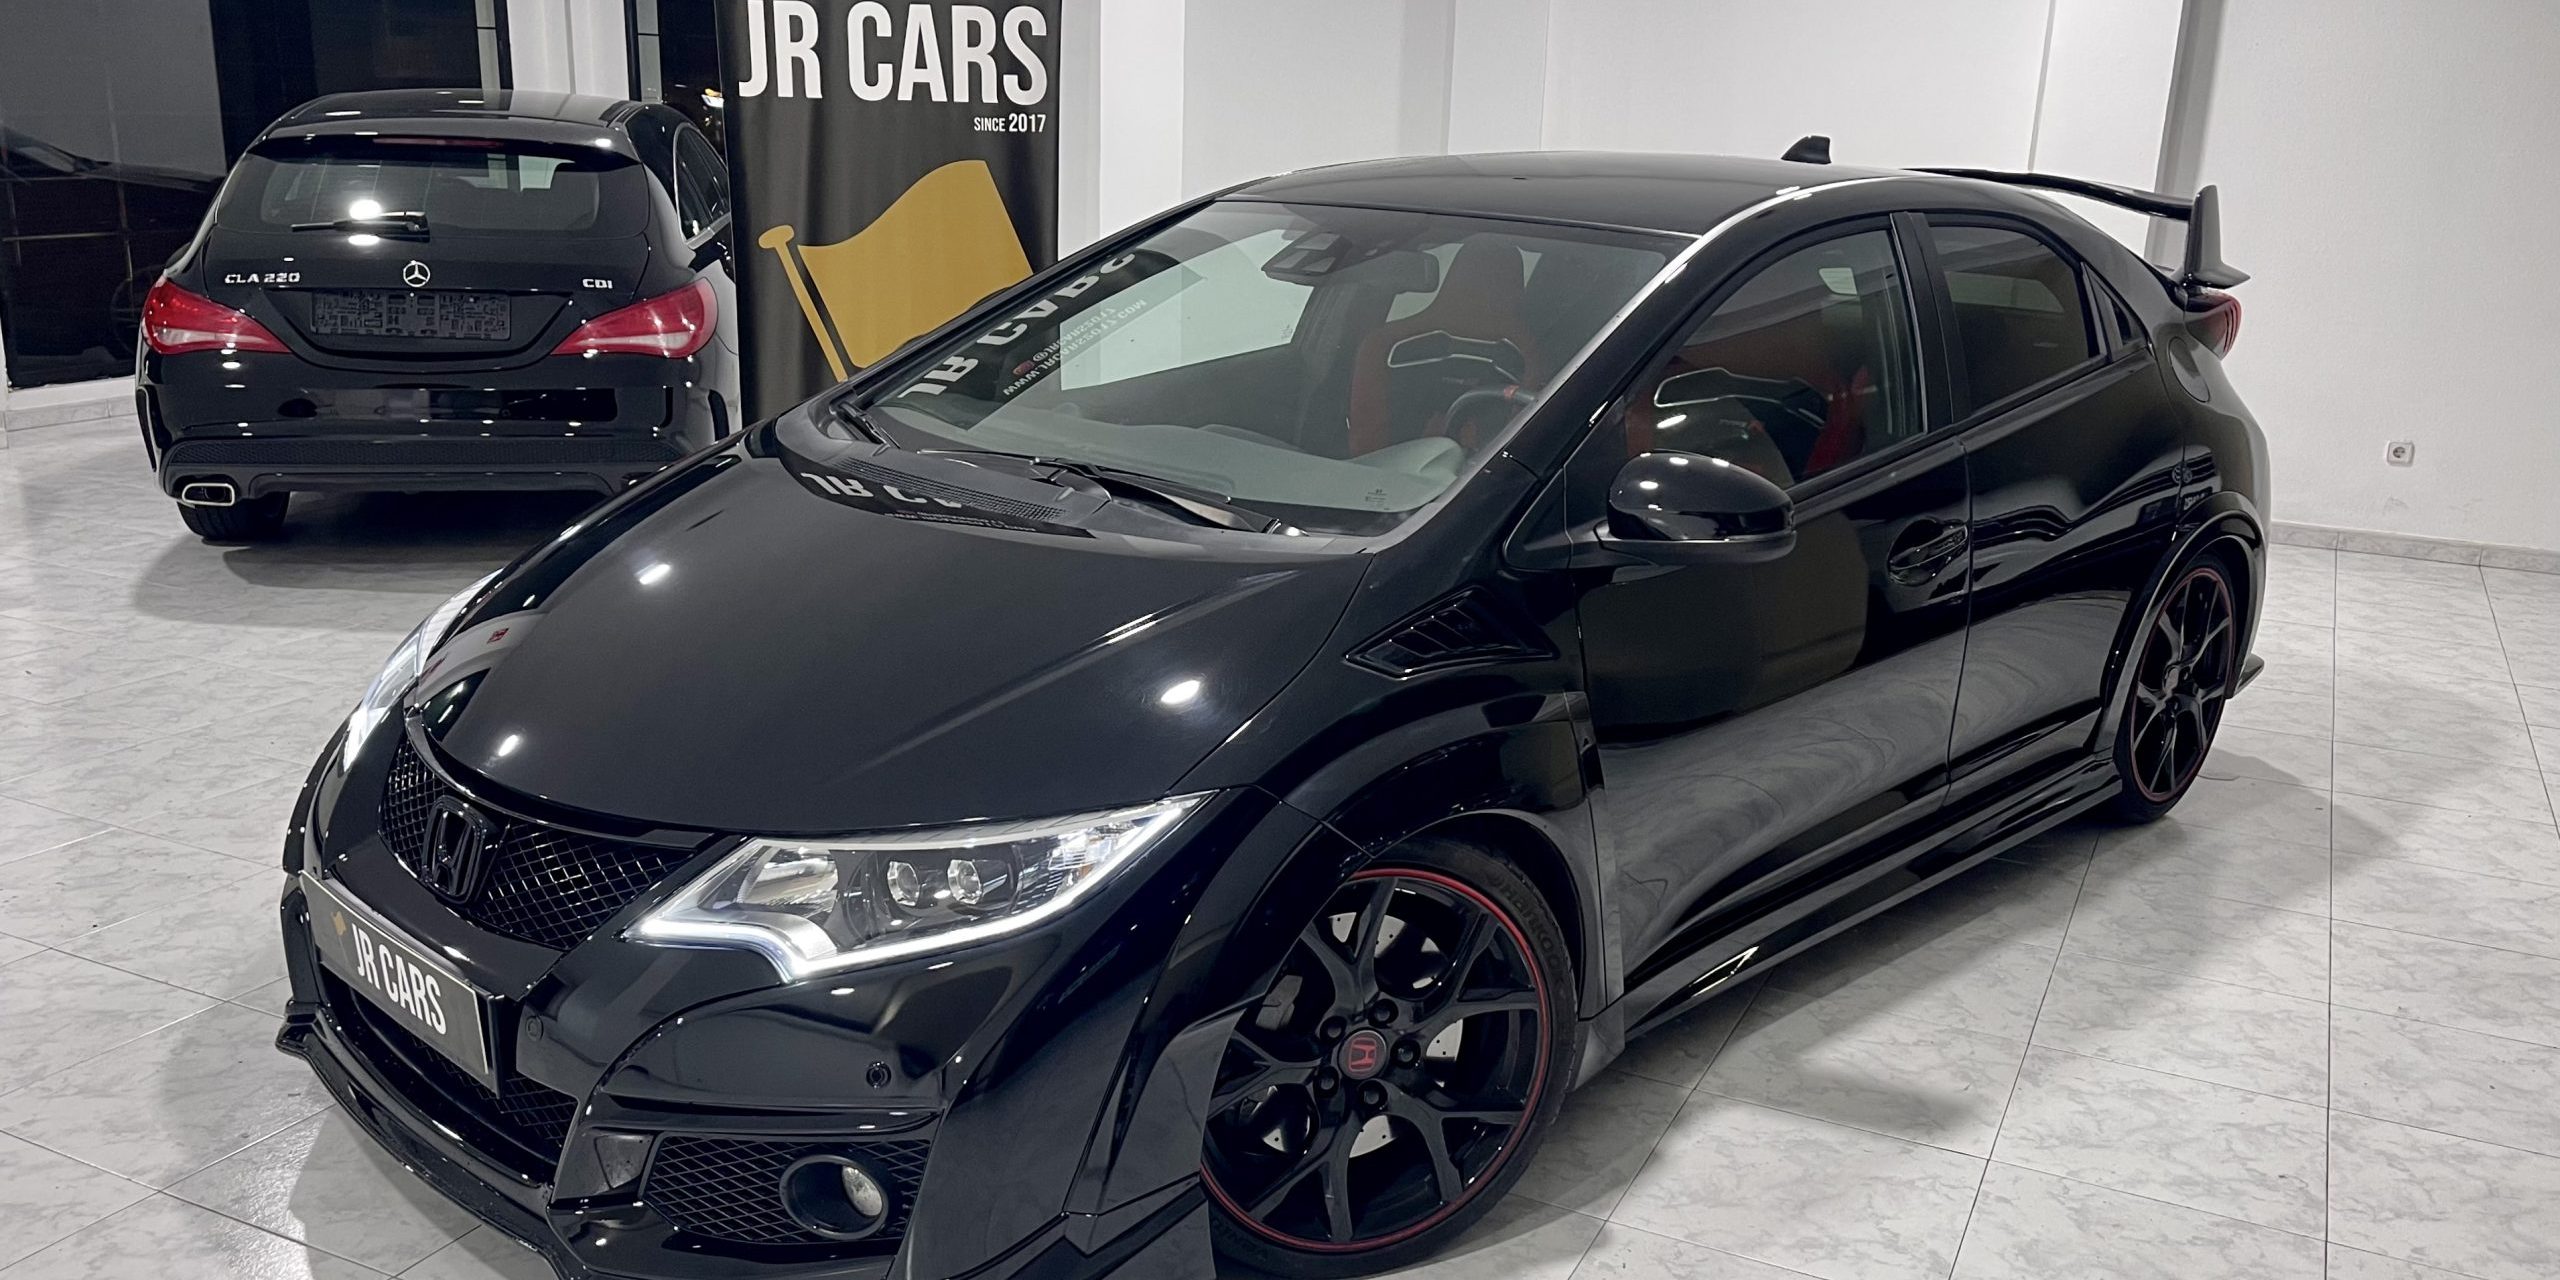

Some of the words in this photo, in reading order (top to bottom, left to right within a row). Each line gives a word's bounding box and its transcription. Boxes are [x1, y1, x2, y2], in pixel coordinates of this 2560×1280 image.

[738, 0, 823, 99] JR
[847, 1, 1047, 106] CARS
[973, 116, 1006, 132] SINCE
[1009, 113, 1046, 132] 2017
[224, 273, 260, 284] CLA
[263, 272, 301, 283] 220
[582, 278, 613, 289] CDI
[352, 923, 381, 990] JR
[378, 944, 447, 1035] CARS
